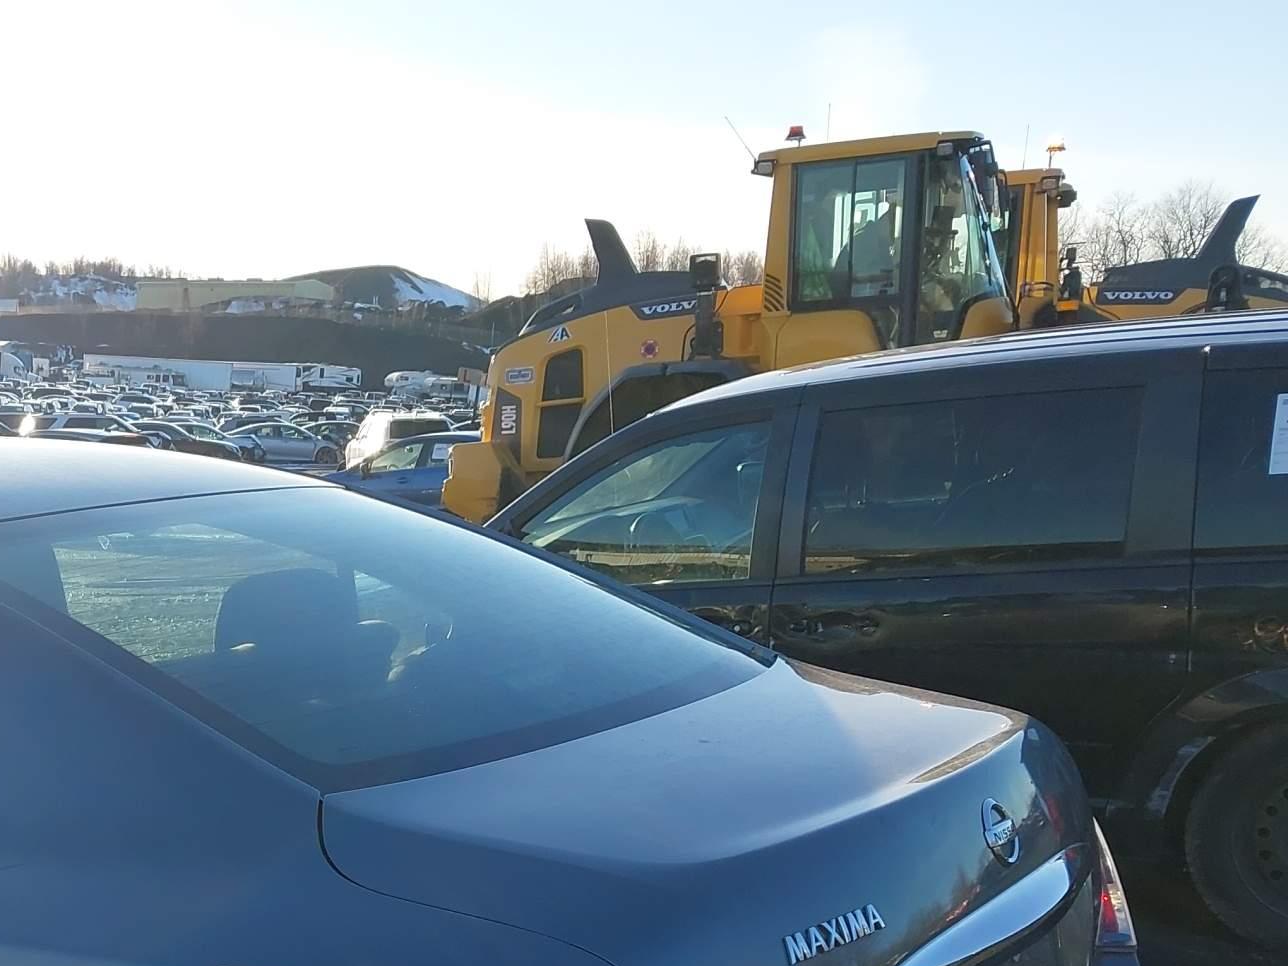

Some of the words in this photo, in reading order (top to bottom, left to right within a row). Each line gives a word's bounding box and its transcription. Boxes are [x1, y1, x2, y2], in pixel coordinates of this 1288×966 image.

[1103, 290, 1174, 301] VOLVO
[640, 300, 697, 316] VOLV
[500, 404, 517, 436] L90H
[783, 903, 886, 966] MAXIMA
